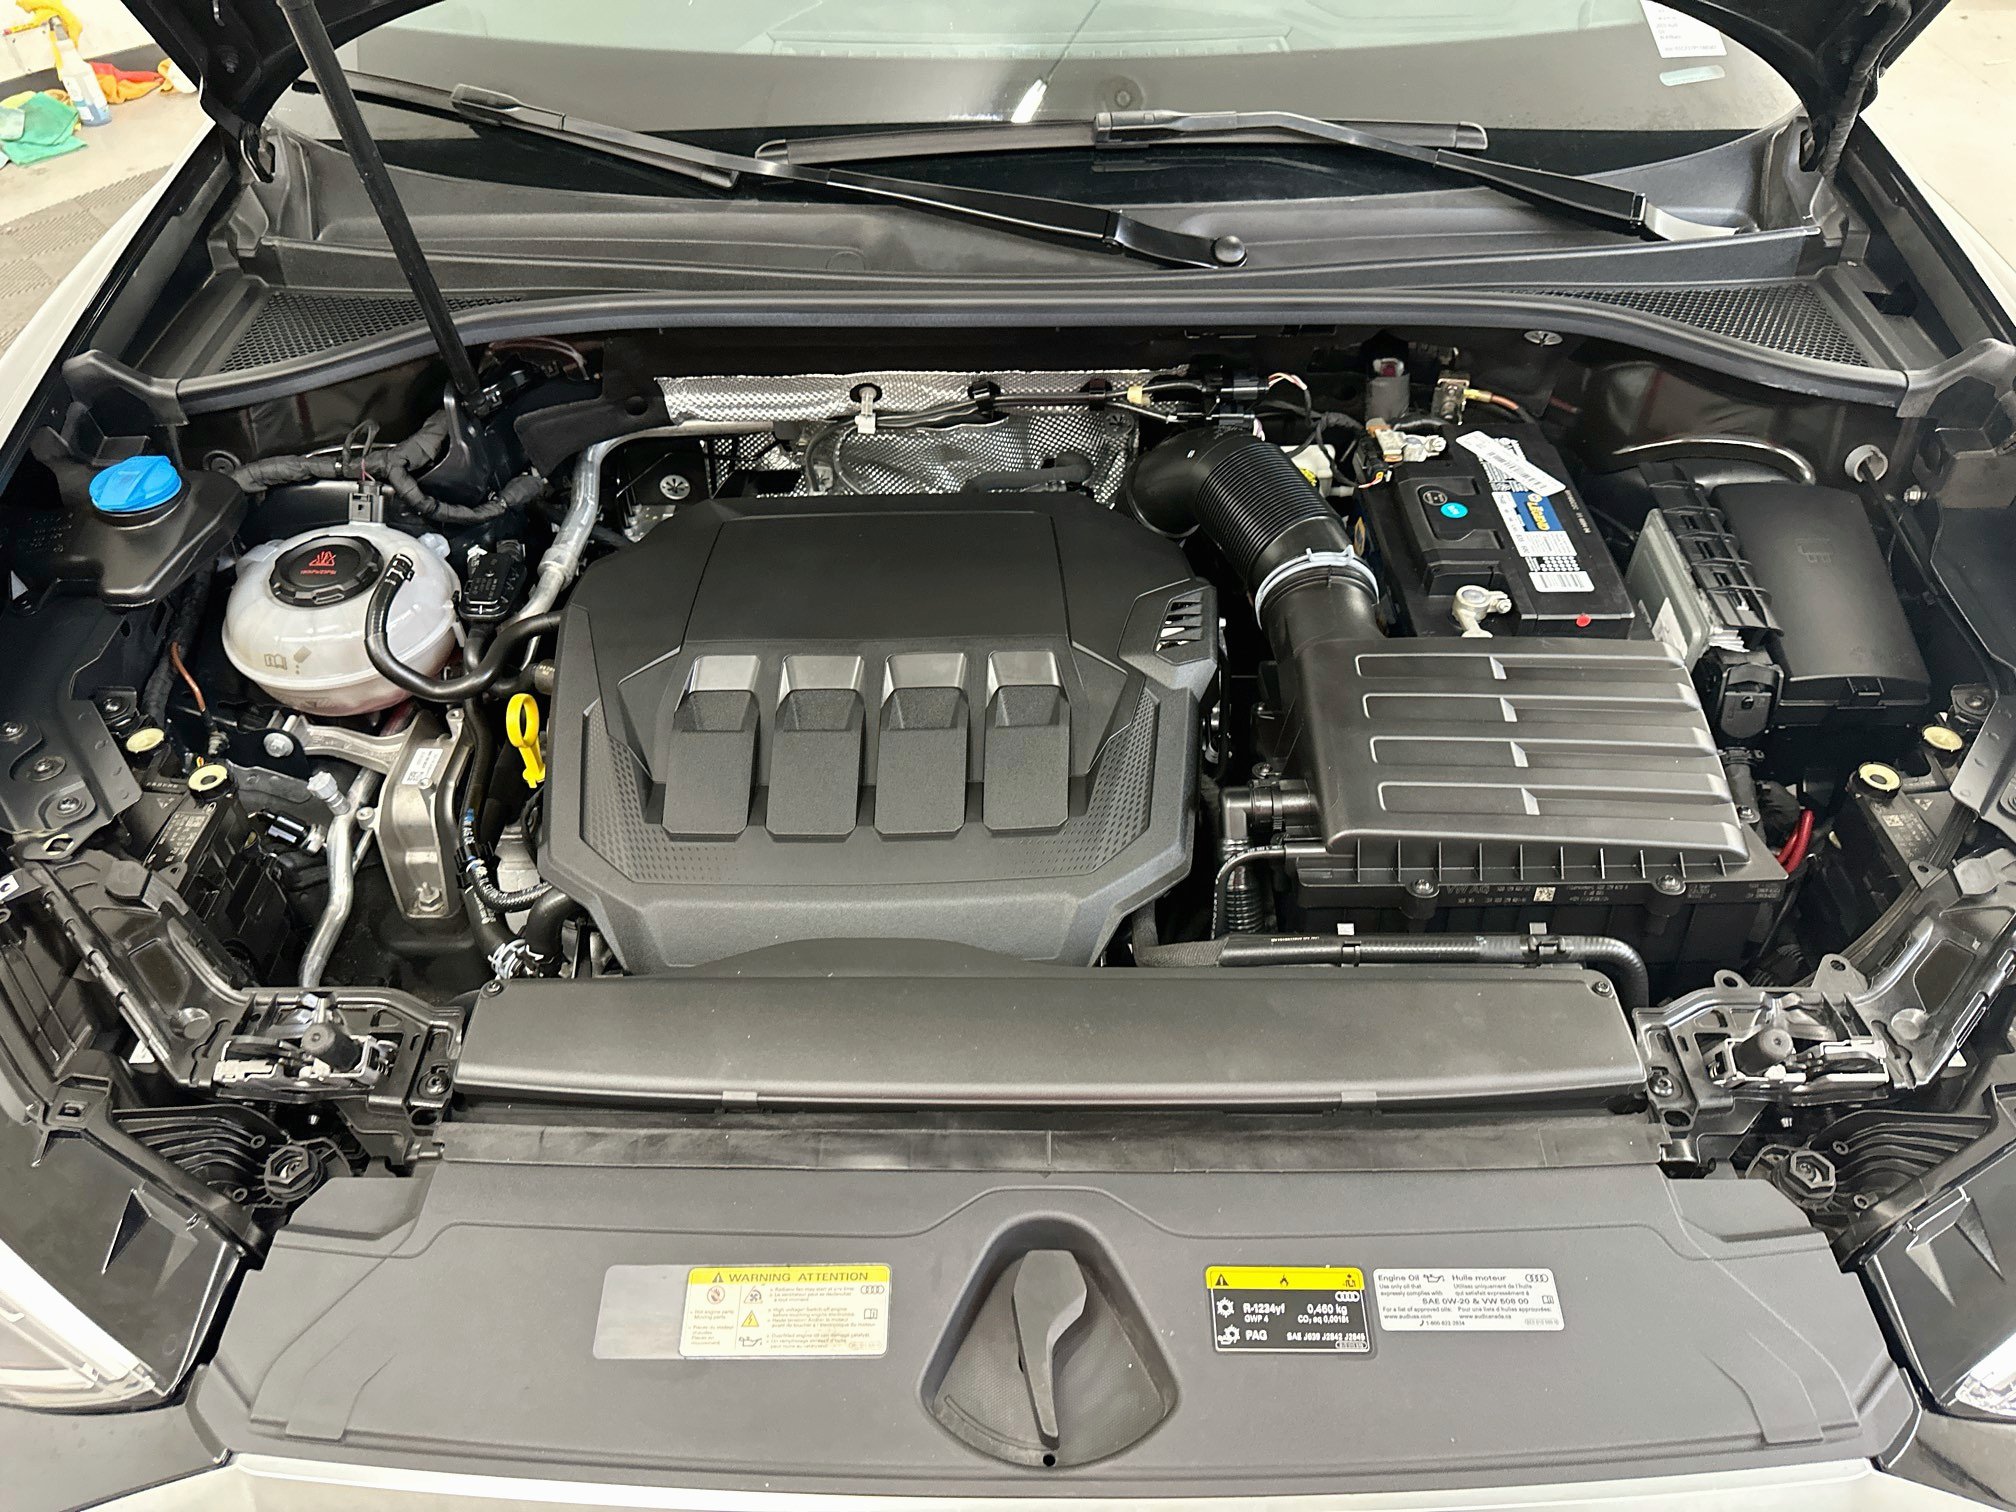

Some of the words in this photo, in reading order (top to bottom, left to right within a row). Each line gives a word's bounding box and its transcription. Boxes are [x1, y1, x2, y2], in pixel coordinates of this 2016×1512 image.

[729, 1273, 791, 1282] WARNING
[798, 1272, 868, 1281] ATTENTION
[1378, 1274, 1406, 1282] Engine
[1408, 1274, 1420, 1282] Oil
[1422, 1297, 1440, 1305] SAE
[1442, 1297, 1470, 1305] 0W-20
[1472, 1297, 1480, 1305] &
[1481, 1297, 1498, 1305] VW
[1518, 1297, 1529, 1305] 00
[1242, 1303, 1285, 1315] R-1234yf
[1335, 1304, 1348, 1315] kg
[1264, 1315, 1269, 1323] 4
[1245, 1330, 1267, 1341] PAG
